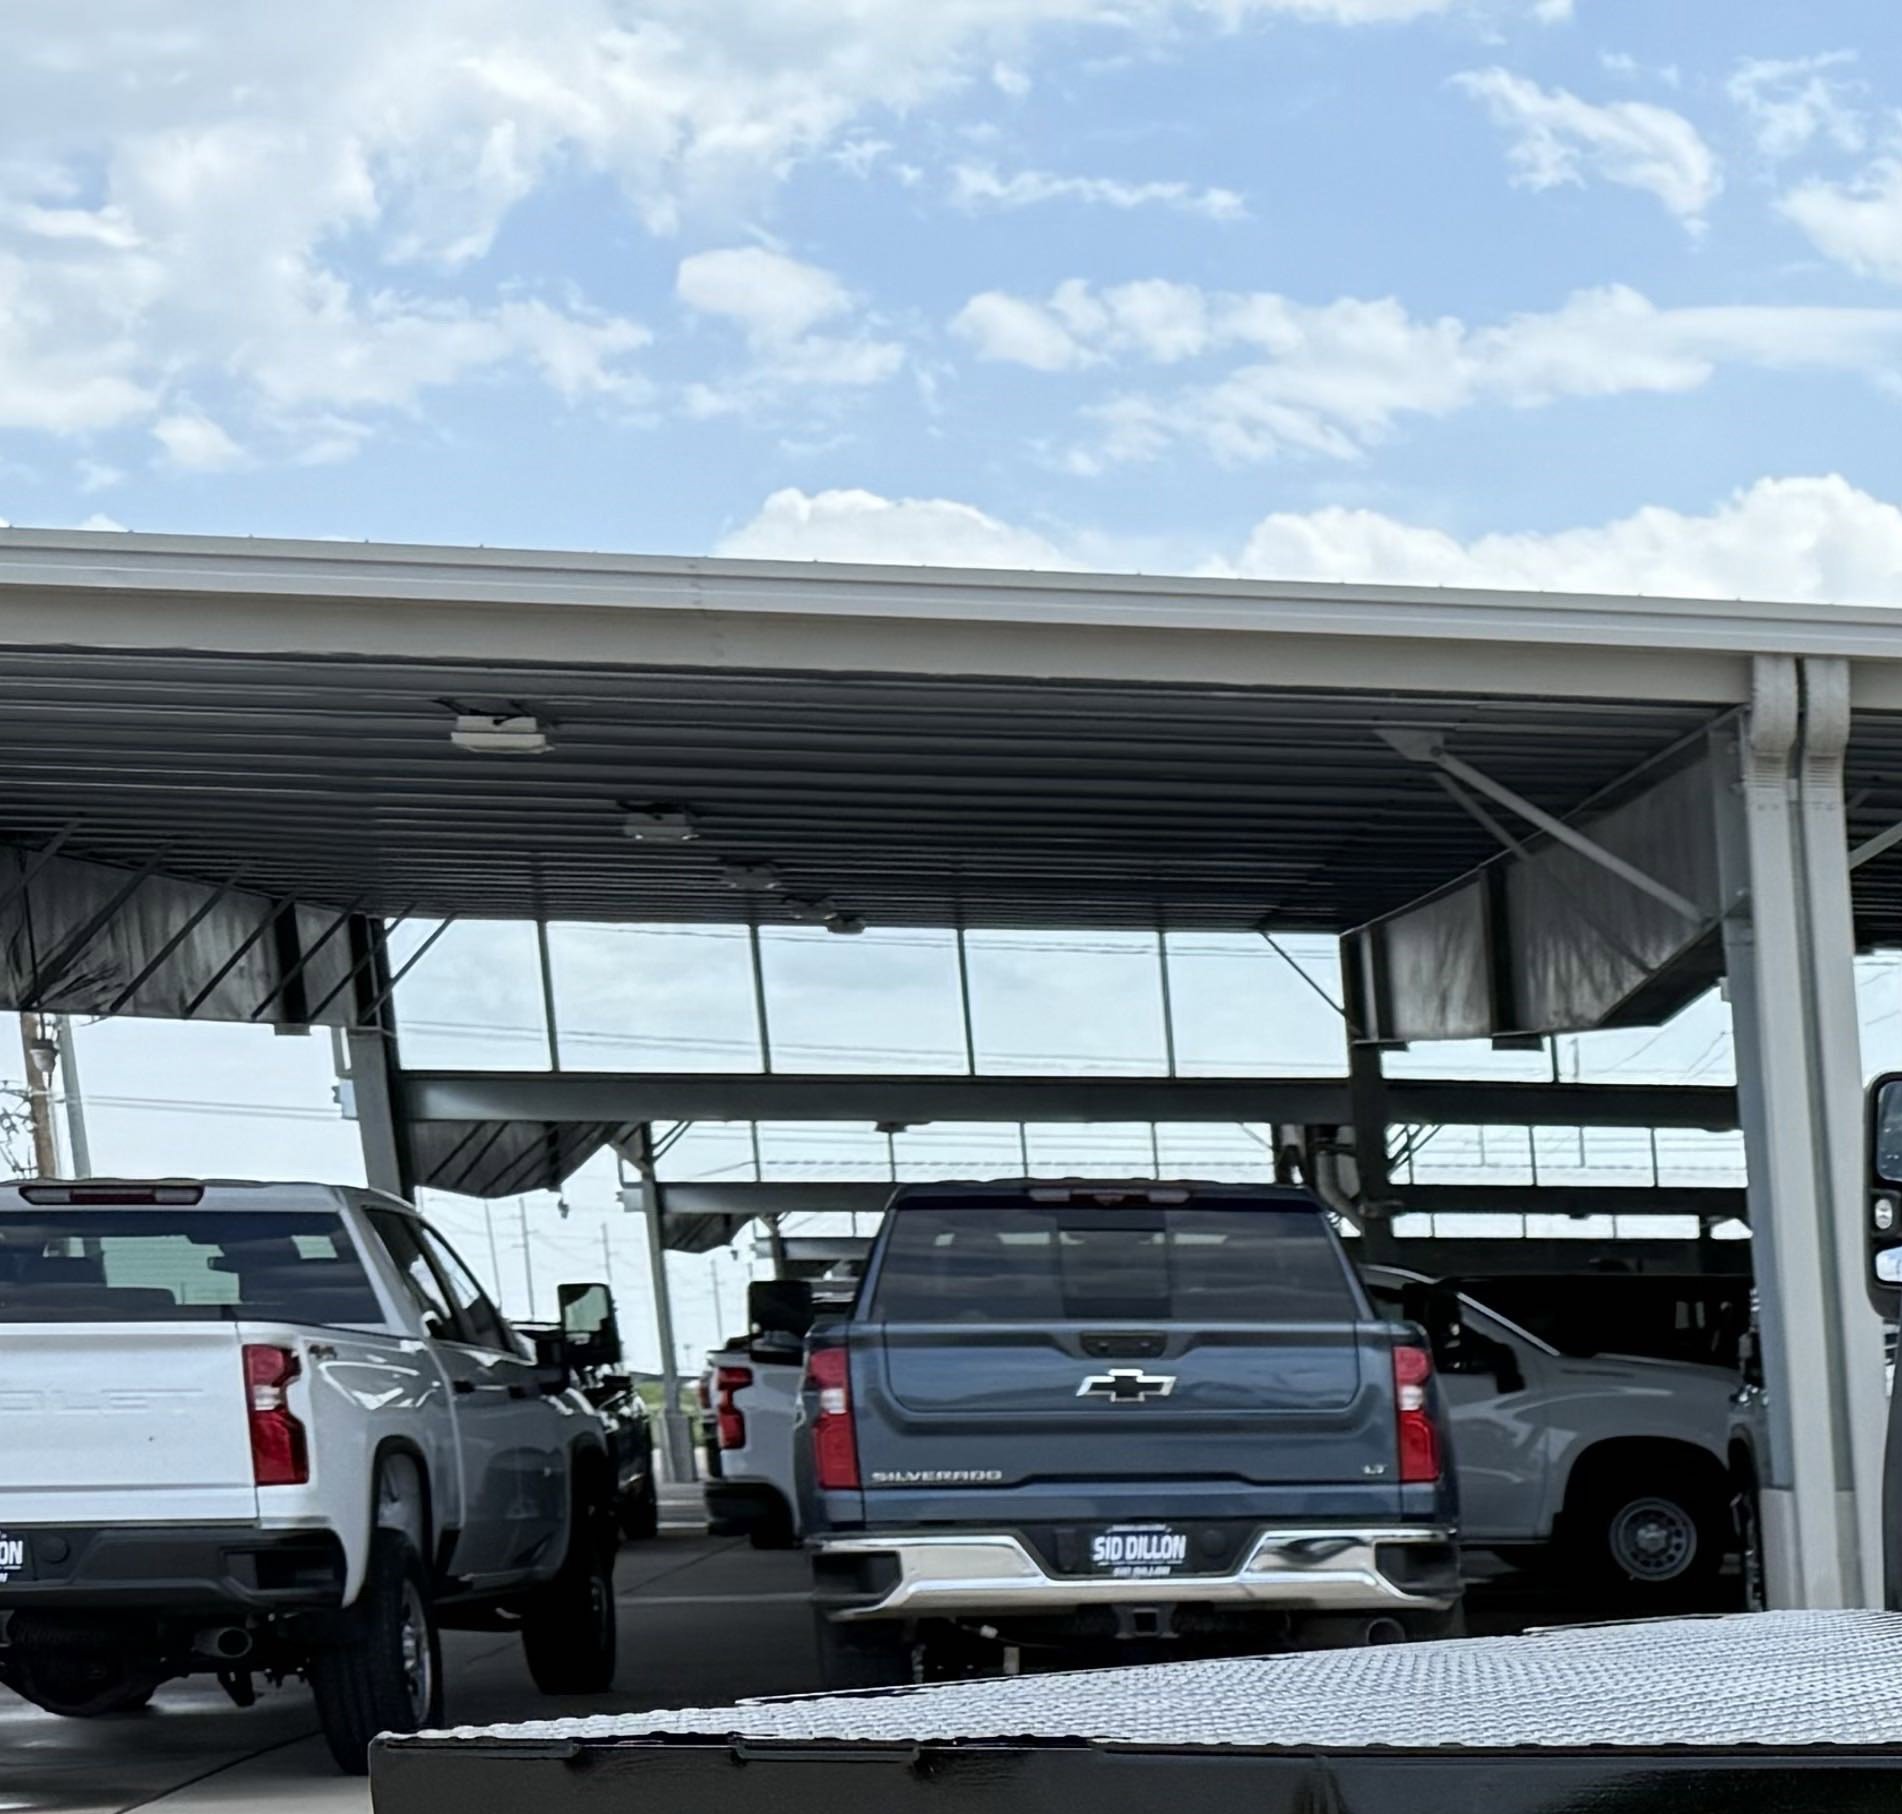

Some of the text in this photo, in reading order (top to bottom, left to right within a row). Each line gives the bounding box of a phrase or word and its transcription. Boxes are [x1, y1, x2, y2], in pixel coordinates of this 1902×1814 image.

[872, 1470, 1002, 1482] SILVERADO
[1093, 1534, 1186, 1561] SID DILLON
